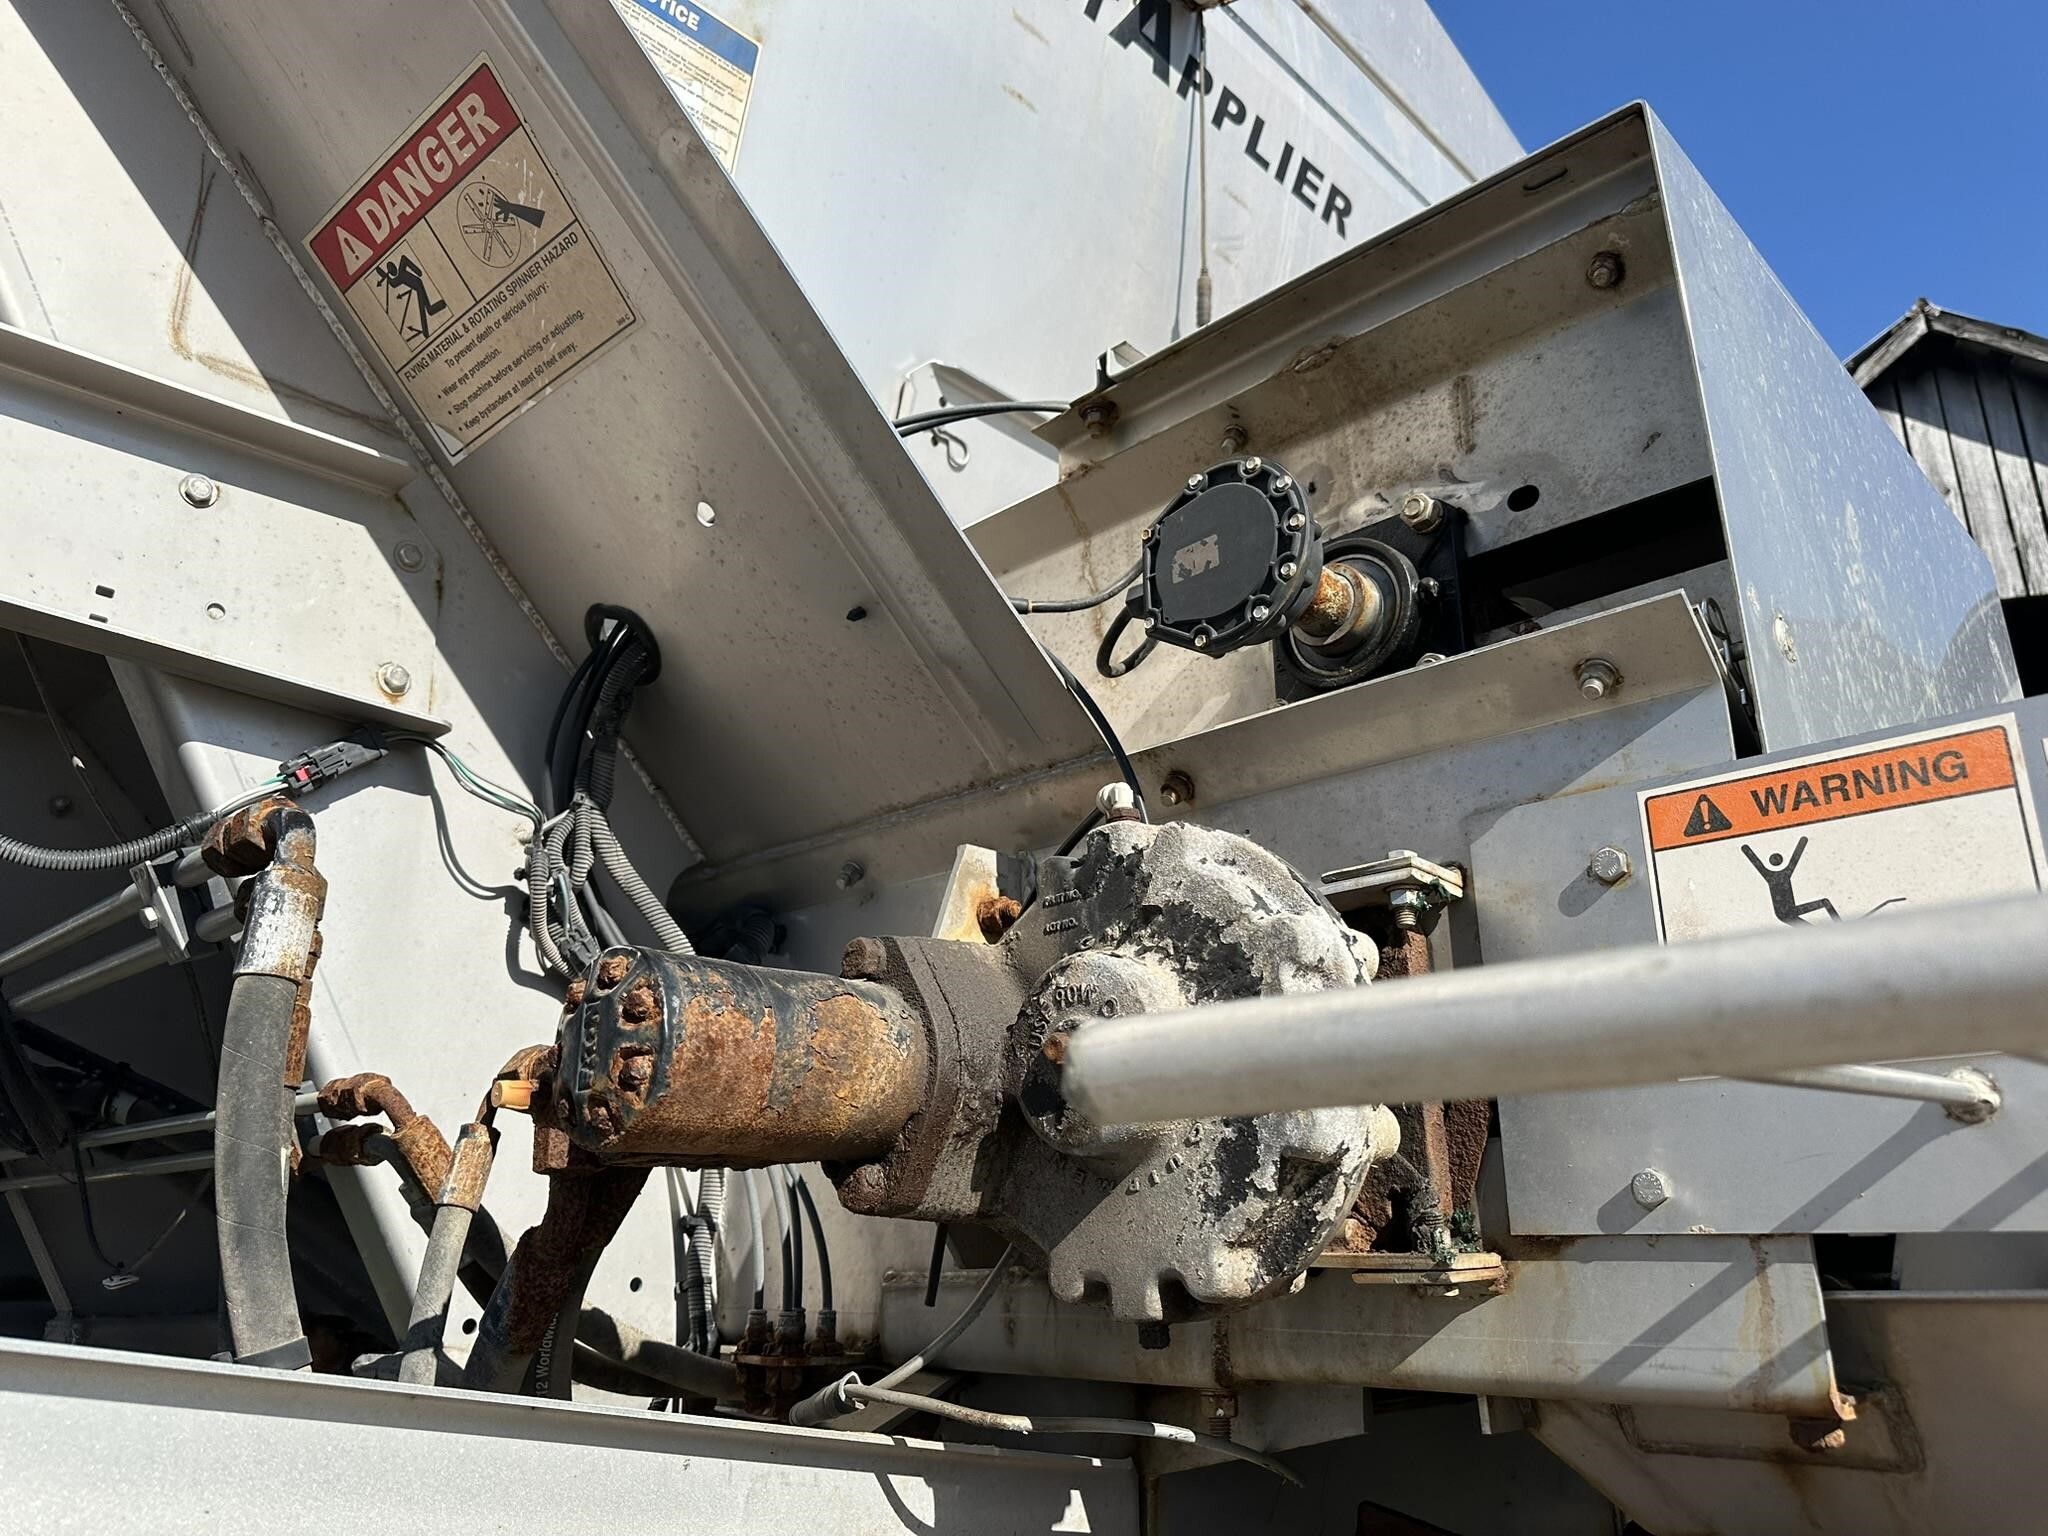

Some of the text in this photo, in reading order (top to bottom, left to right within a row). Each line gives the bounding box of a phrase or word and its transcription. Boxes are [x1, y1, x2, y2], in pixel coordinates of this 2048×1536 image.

[355, 92, 500, 244] DANGER
[403, 231, 578, 381] FLYING MATERIAL & ROTATING SPINNER HAZARD
[444, 279, 550, 368] To prevent death or serious injury:
[441, 346, 501, 397] Wear eye protection.
[452, 306, 585, 414] Stop machine before servicing or adjusting.
[463, 340, 578, 431] Keep bystanders at least 60 feet away.
[1751, 750, 1969, 817] WARNING
